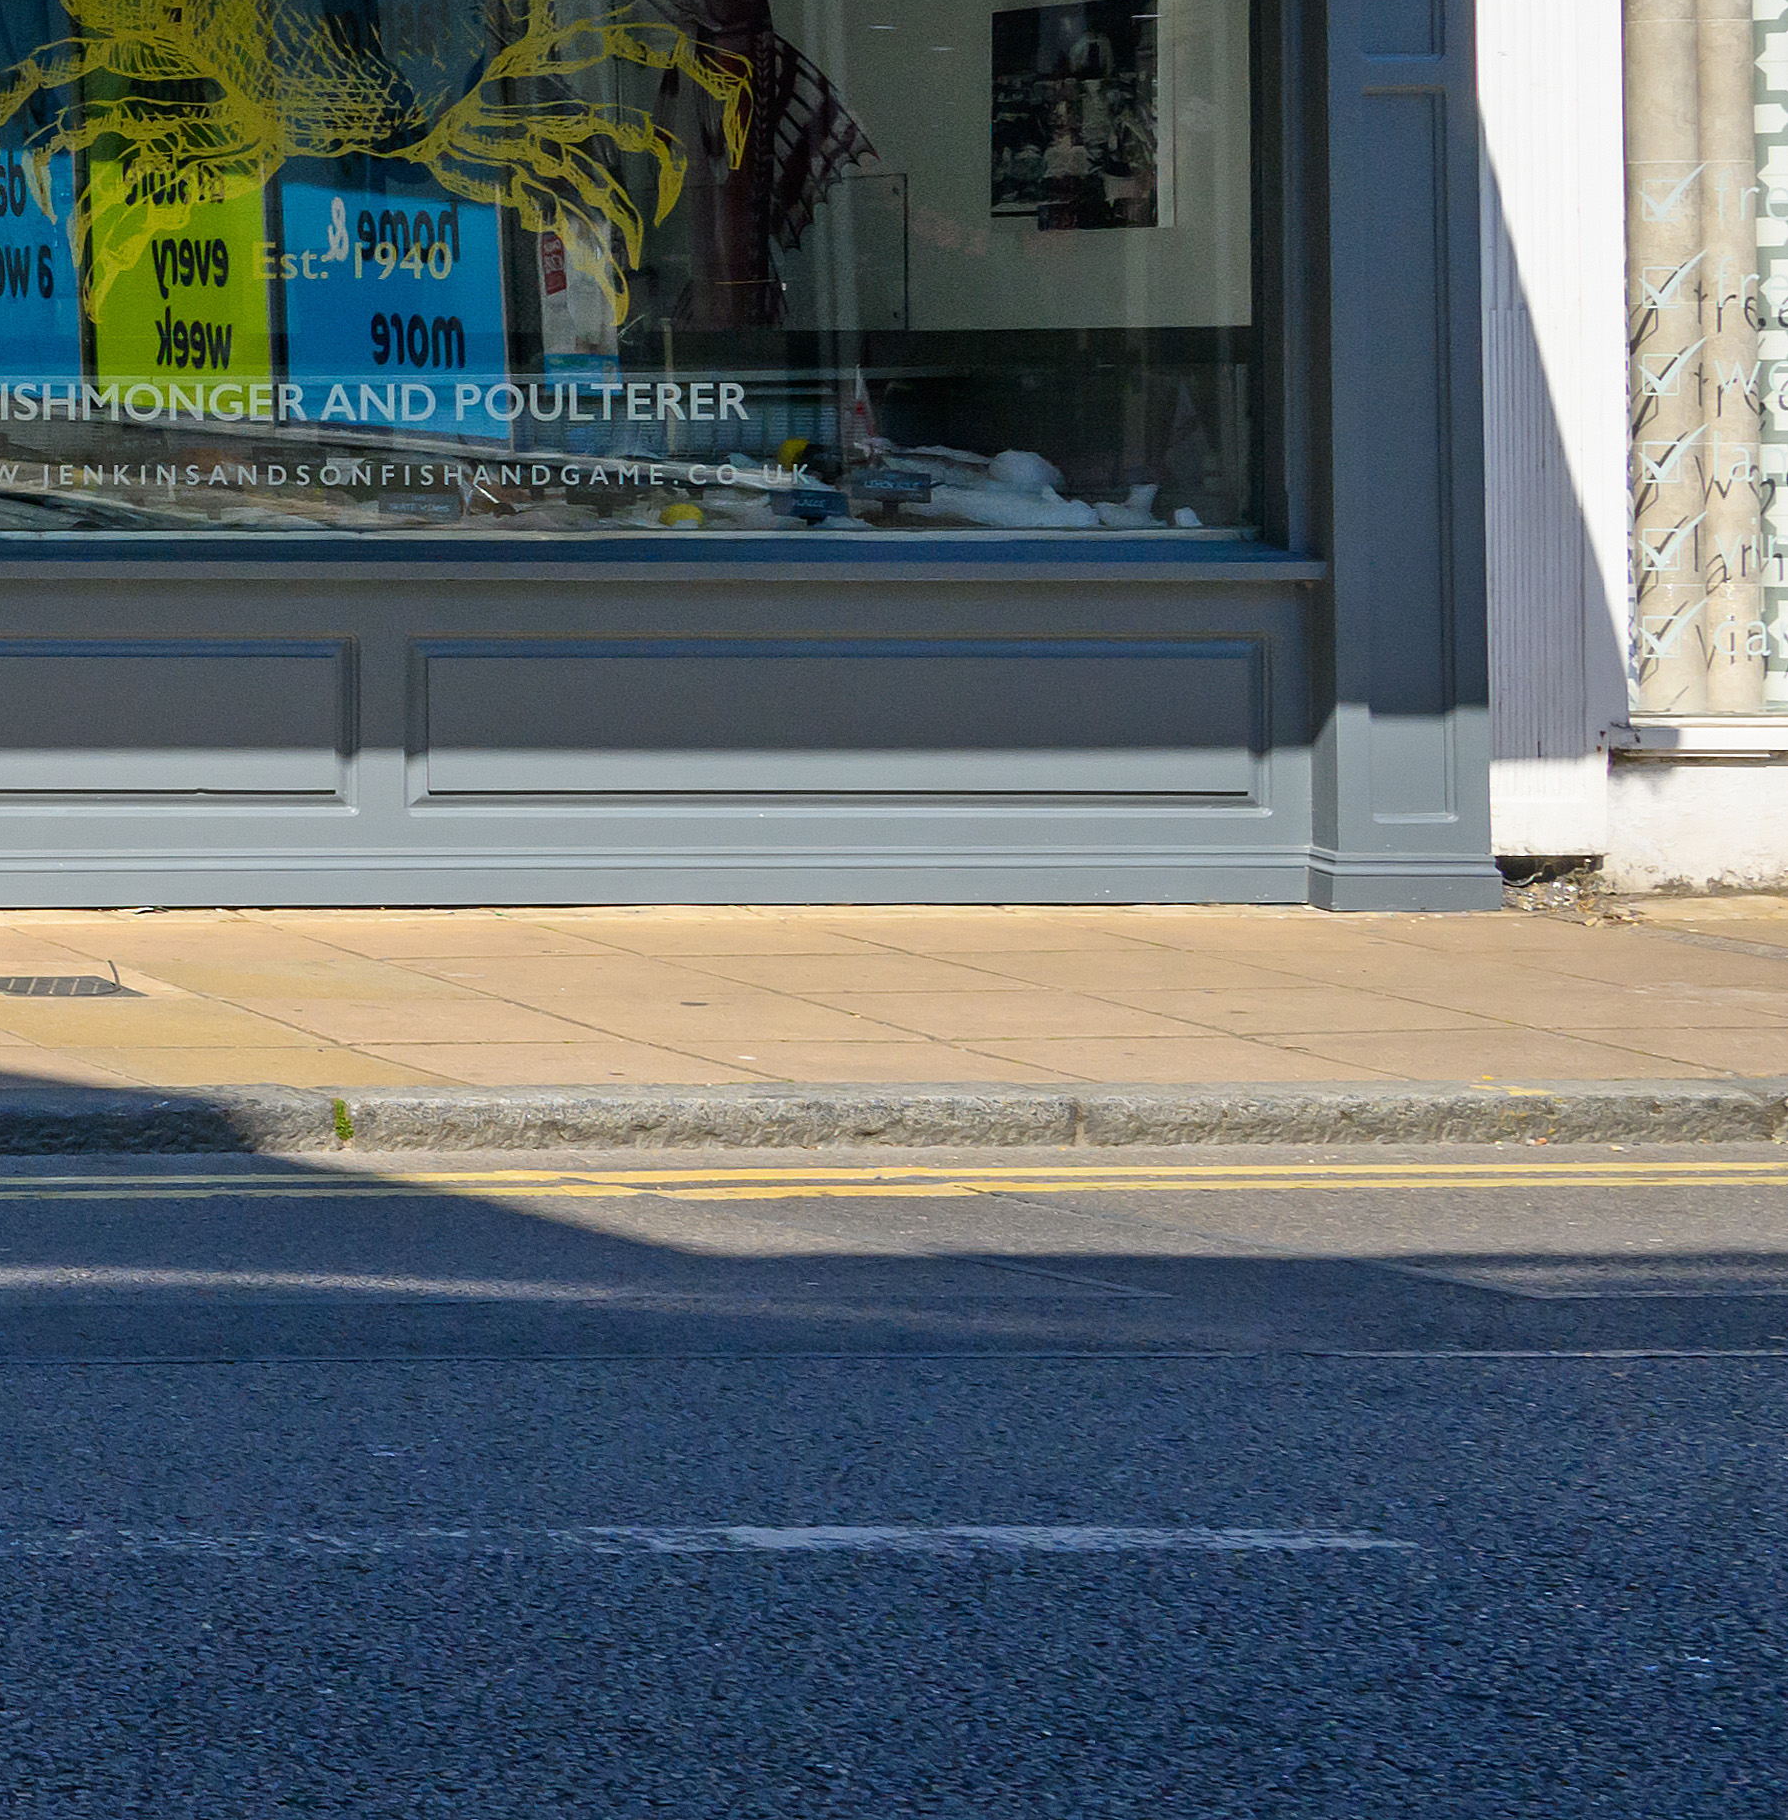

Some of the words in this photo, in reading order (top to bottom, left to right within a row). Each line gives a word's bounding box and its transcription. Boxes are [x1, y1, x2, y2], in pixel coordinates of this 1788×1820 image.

[251, 241, 329, 281] Est:
[354, 241, 454, 281] 1940
[321, 382, 438, 422] AND
[455, 381, 751, 422] POULTERER
